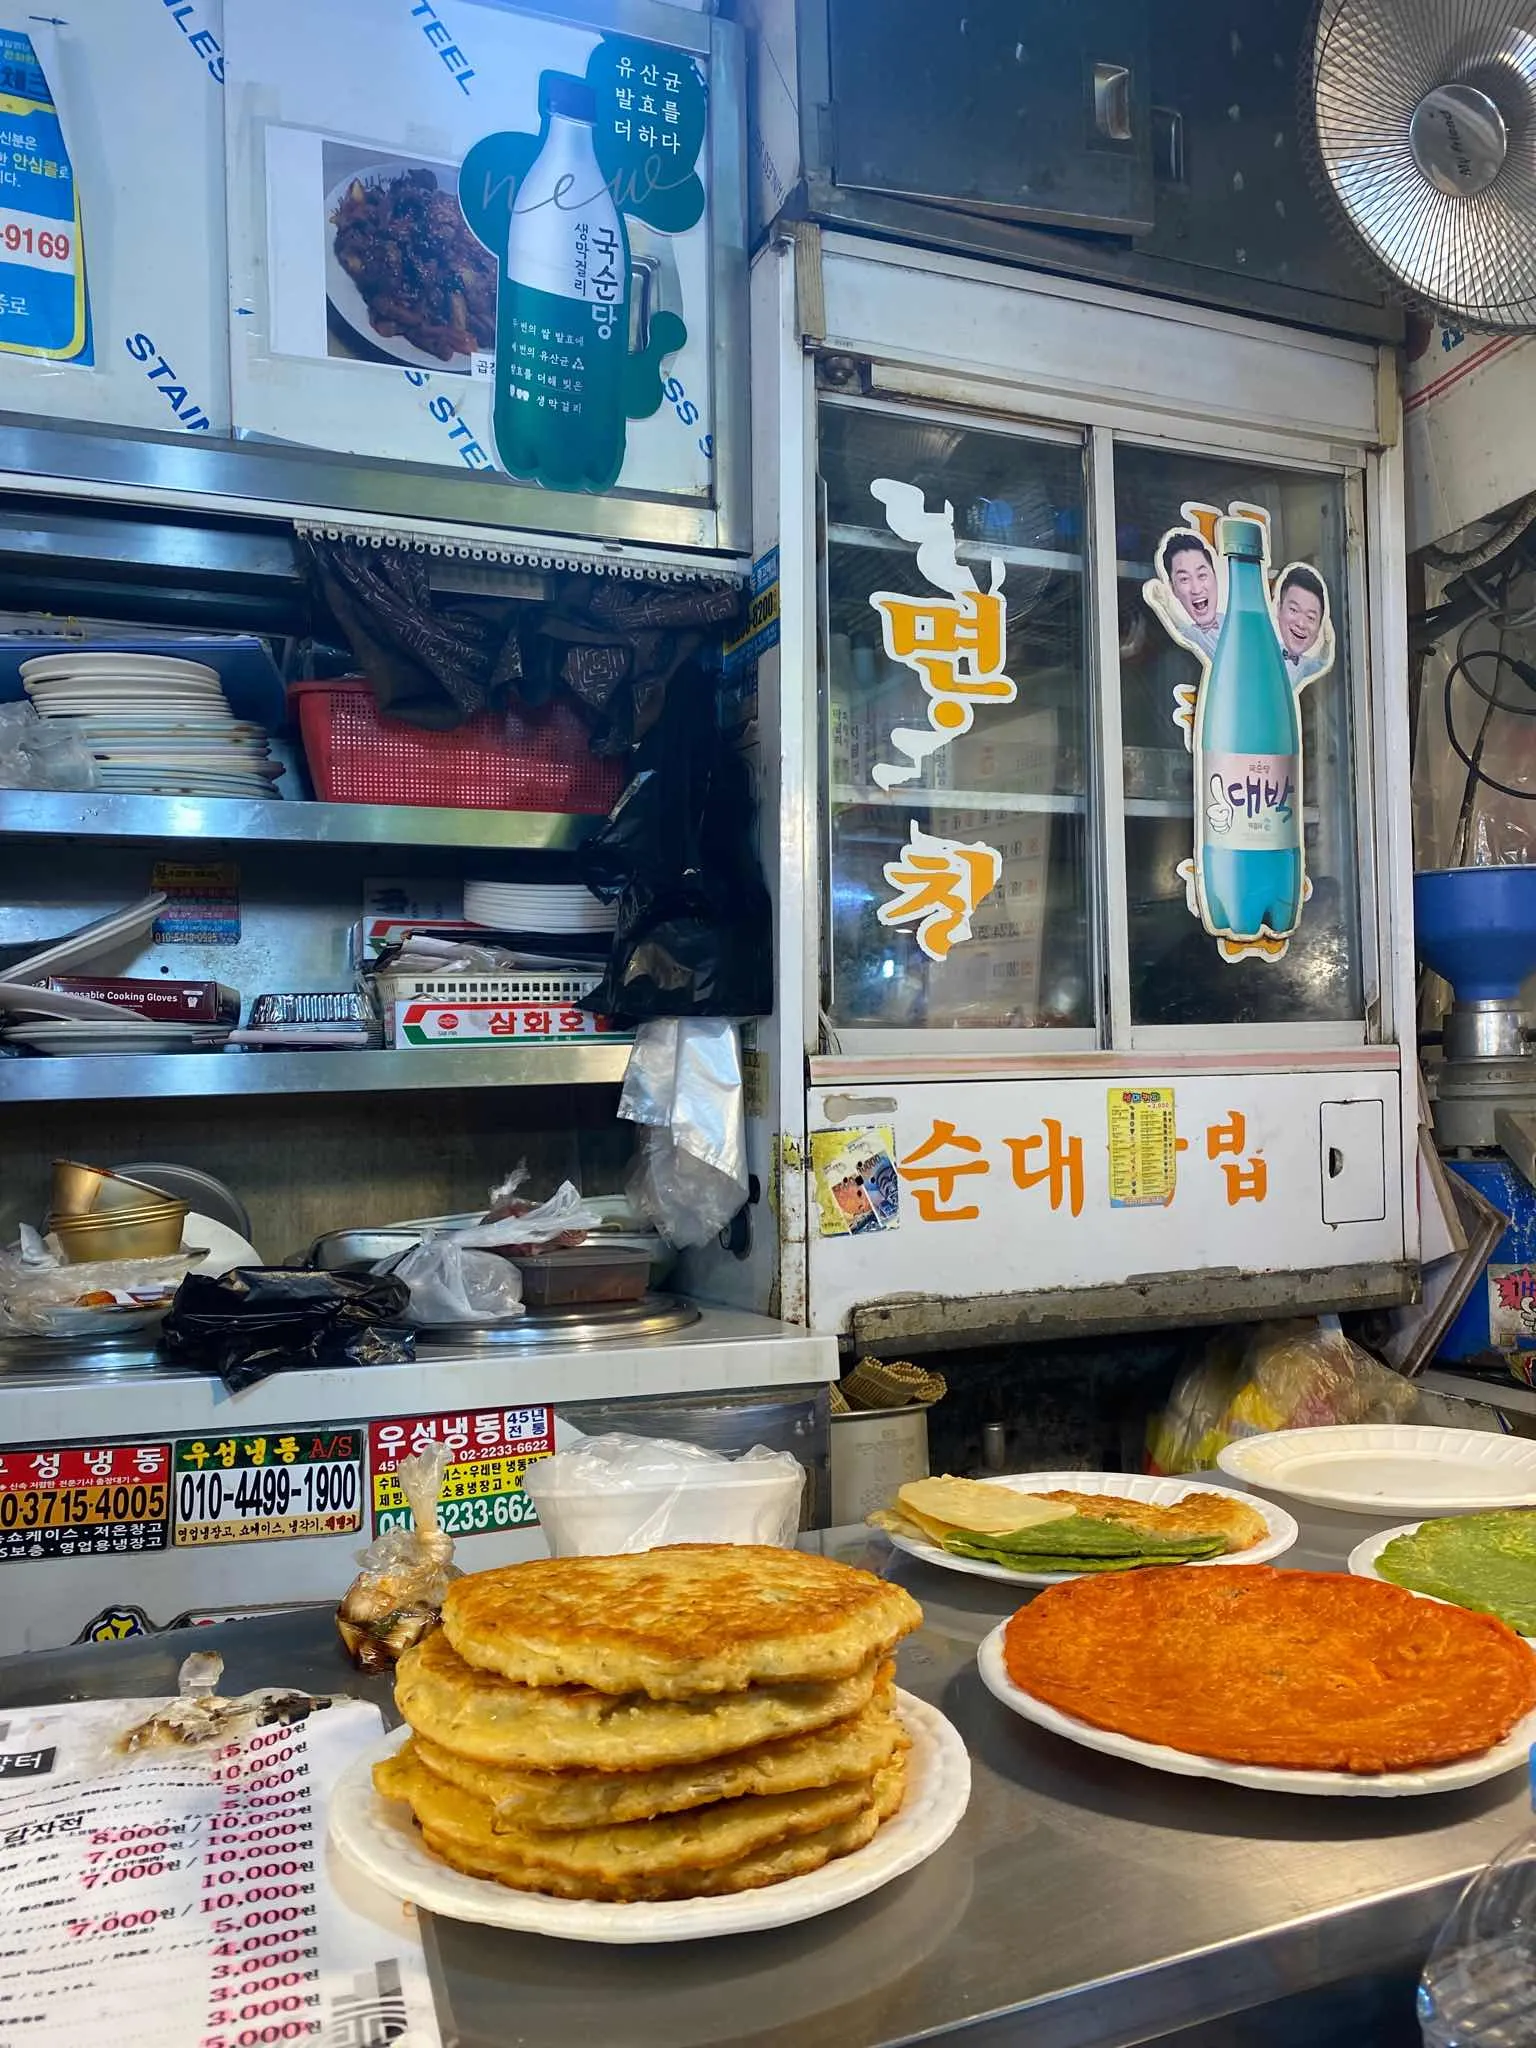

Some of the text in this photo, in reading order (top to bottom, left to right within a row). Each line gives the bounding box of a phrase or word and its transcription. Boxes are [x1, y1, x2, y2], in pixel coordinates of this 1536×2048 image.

[615, 56, 682, 94] 유산균
[614, 87, 681, 125] 발효를
[614, 119, 681, 156] 더하다
[483, 153, 696, 214] new
[574, 223, 590, 297] 생막걸리
[591, 227, 620, 341] 국순당
[540, 350, 570, 368] 유산균
[1227, 775, 1295, 824] 대박
[106, 991, 145, 1004] Cooking
[146, 993, 178, 1003] Gloves
[378, 1407, 544, 1458] 우성냉동 45년
[508, 1421, 546, 1439] 전통
[182, 1435, 353, 1470] 우성냉동 A/S
[459, 1440, 549, 1462] 02-2233-6622
[180, 1463, 356, 1522] 010-4499-1900
[60, 1536, 163, 1555] 영업용냉장고
[94, 1522, 164, 1537] 저온창고
[213, 1741, 310, 1781] 10,000원
[224, 1763, 312, 1795] 5,000원
[222, 1786, 313, 1810] 5,000원
[91, 1823, 186, 1846] 8,000원
[207, 1805, 313, 1832] 10,000원
[87, 1841, 184, 1865] 7,000원
[207, 1822, 314, 1848] 10,000원
[82, 1859, 181, 1891] 7,000원
[204, 1840, 315, 1866] 10,000원
[201, 1861, 316, 1889] 10,000원
[71, 1907, 176, 1938] 7,000원
[199, 1882, 317, 1915] 10,000원
[214, 1904, 318, 1934] 5,000원
[213, 1925, 319, 1957] 4,000원
[210, 1946, 319, 1980] 3,000원
[208, 1969, 319, 2003] 3,000원
[207, 1993, 322, 2027] 3,000원
